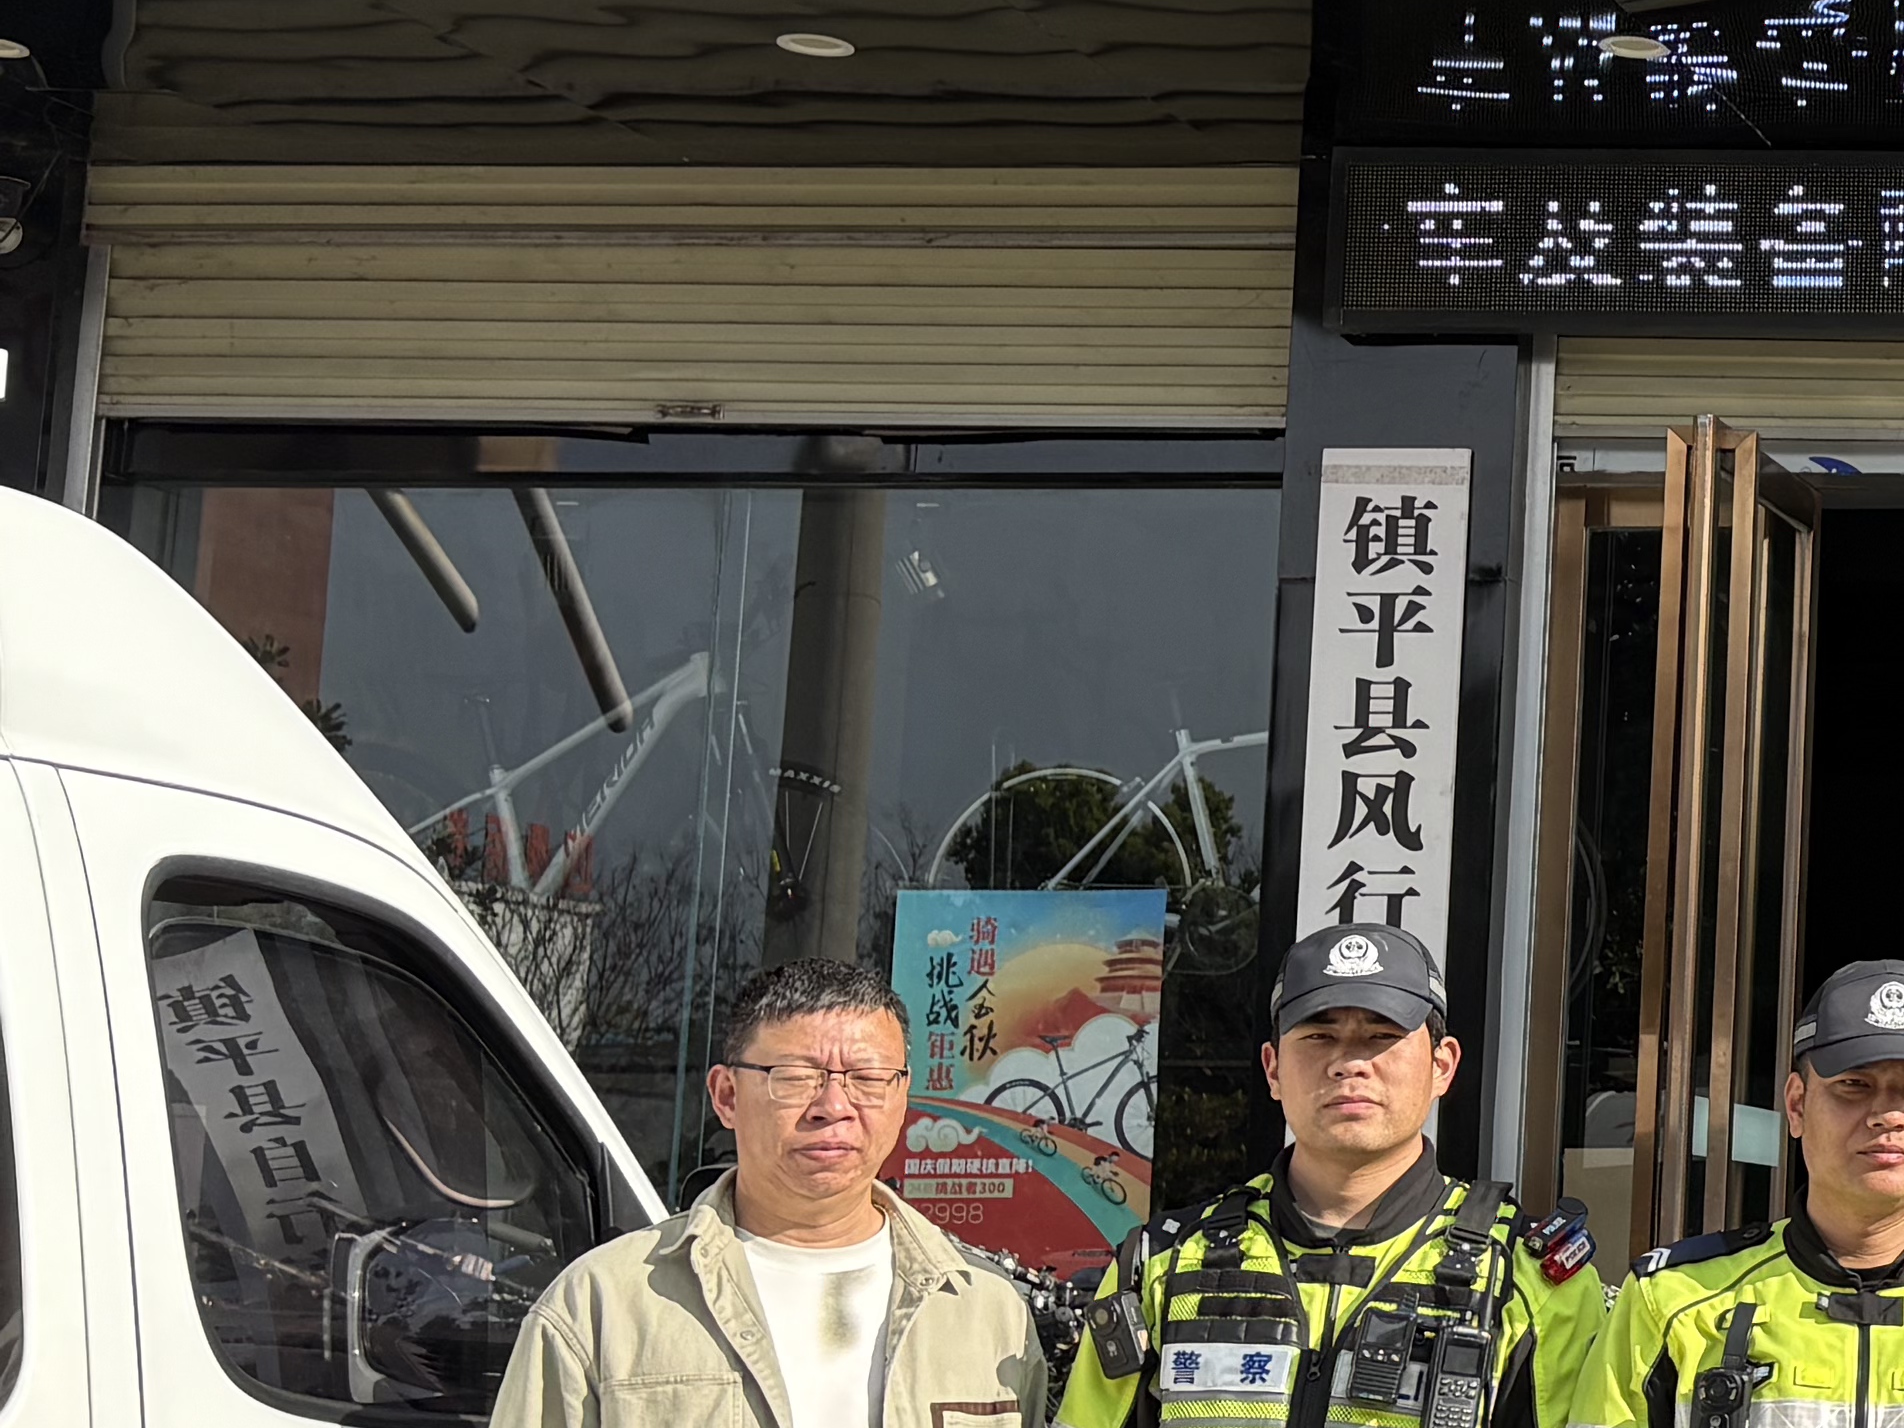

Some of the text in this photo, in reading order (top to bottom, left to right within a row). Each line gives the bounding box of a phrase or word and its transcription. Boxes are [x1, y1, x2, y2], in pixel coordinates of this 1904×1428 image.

[925, 951, 964, 1092] 挑战钜惠
[959, 915, 998, 1062] 骑遇金秋
[1170, 1349, 1273, 1386] 警察
